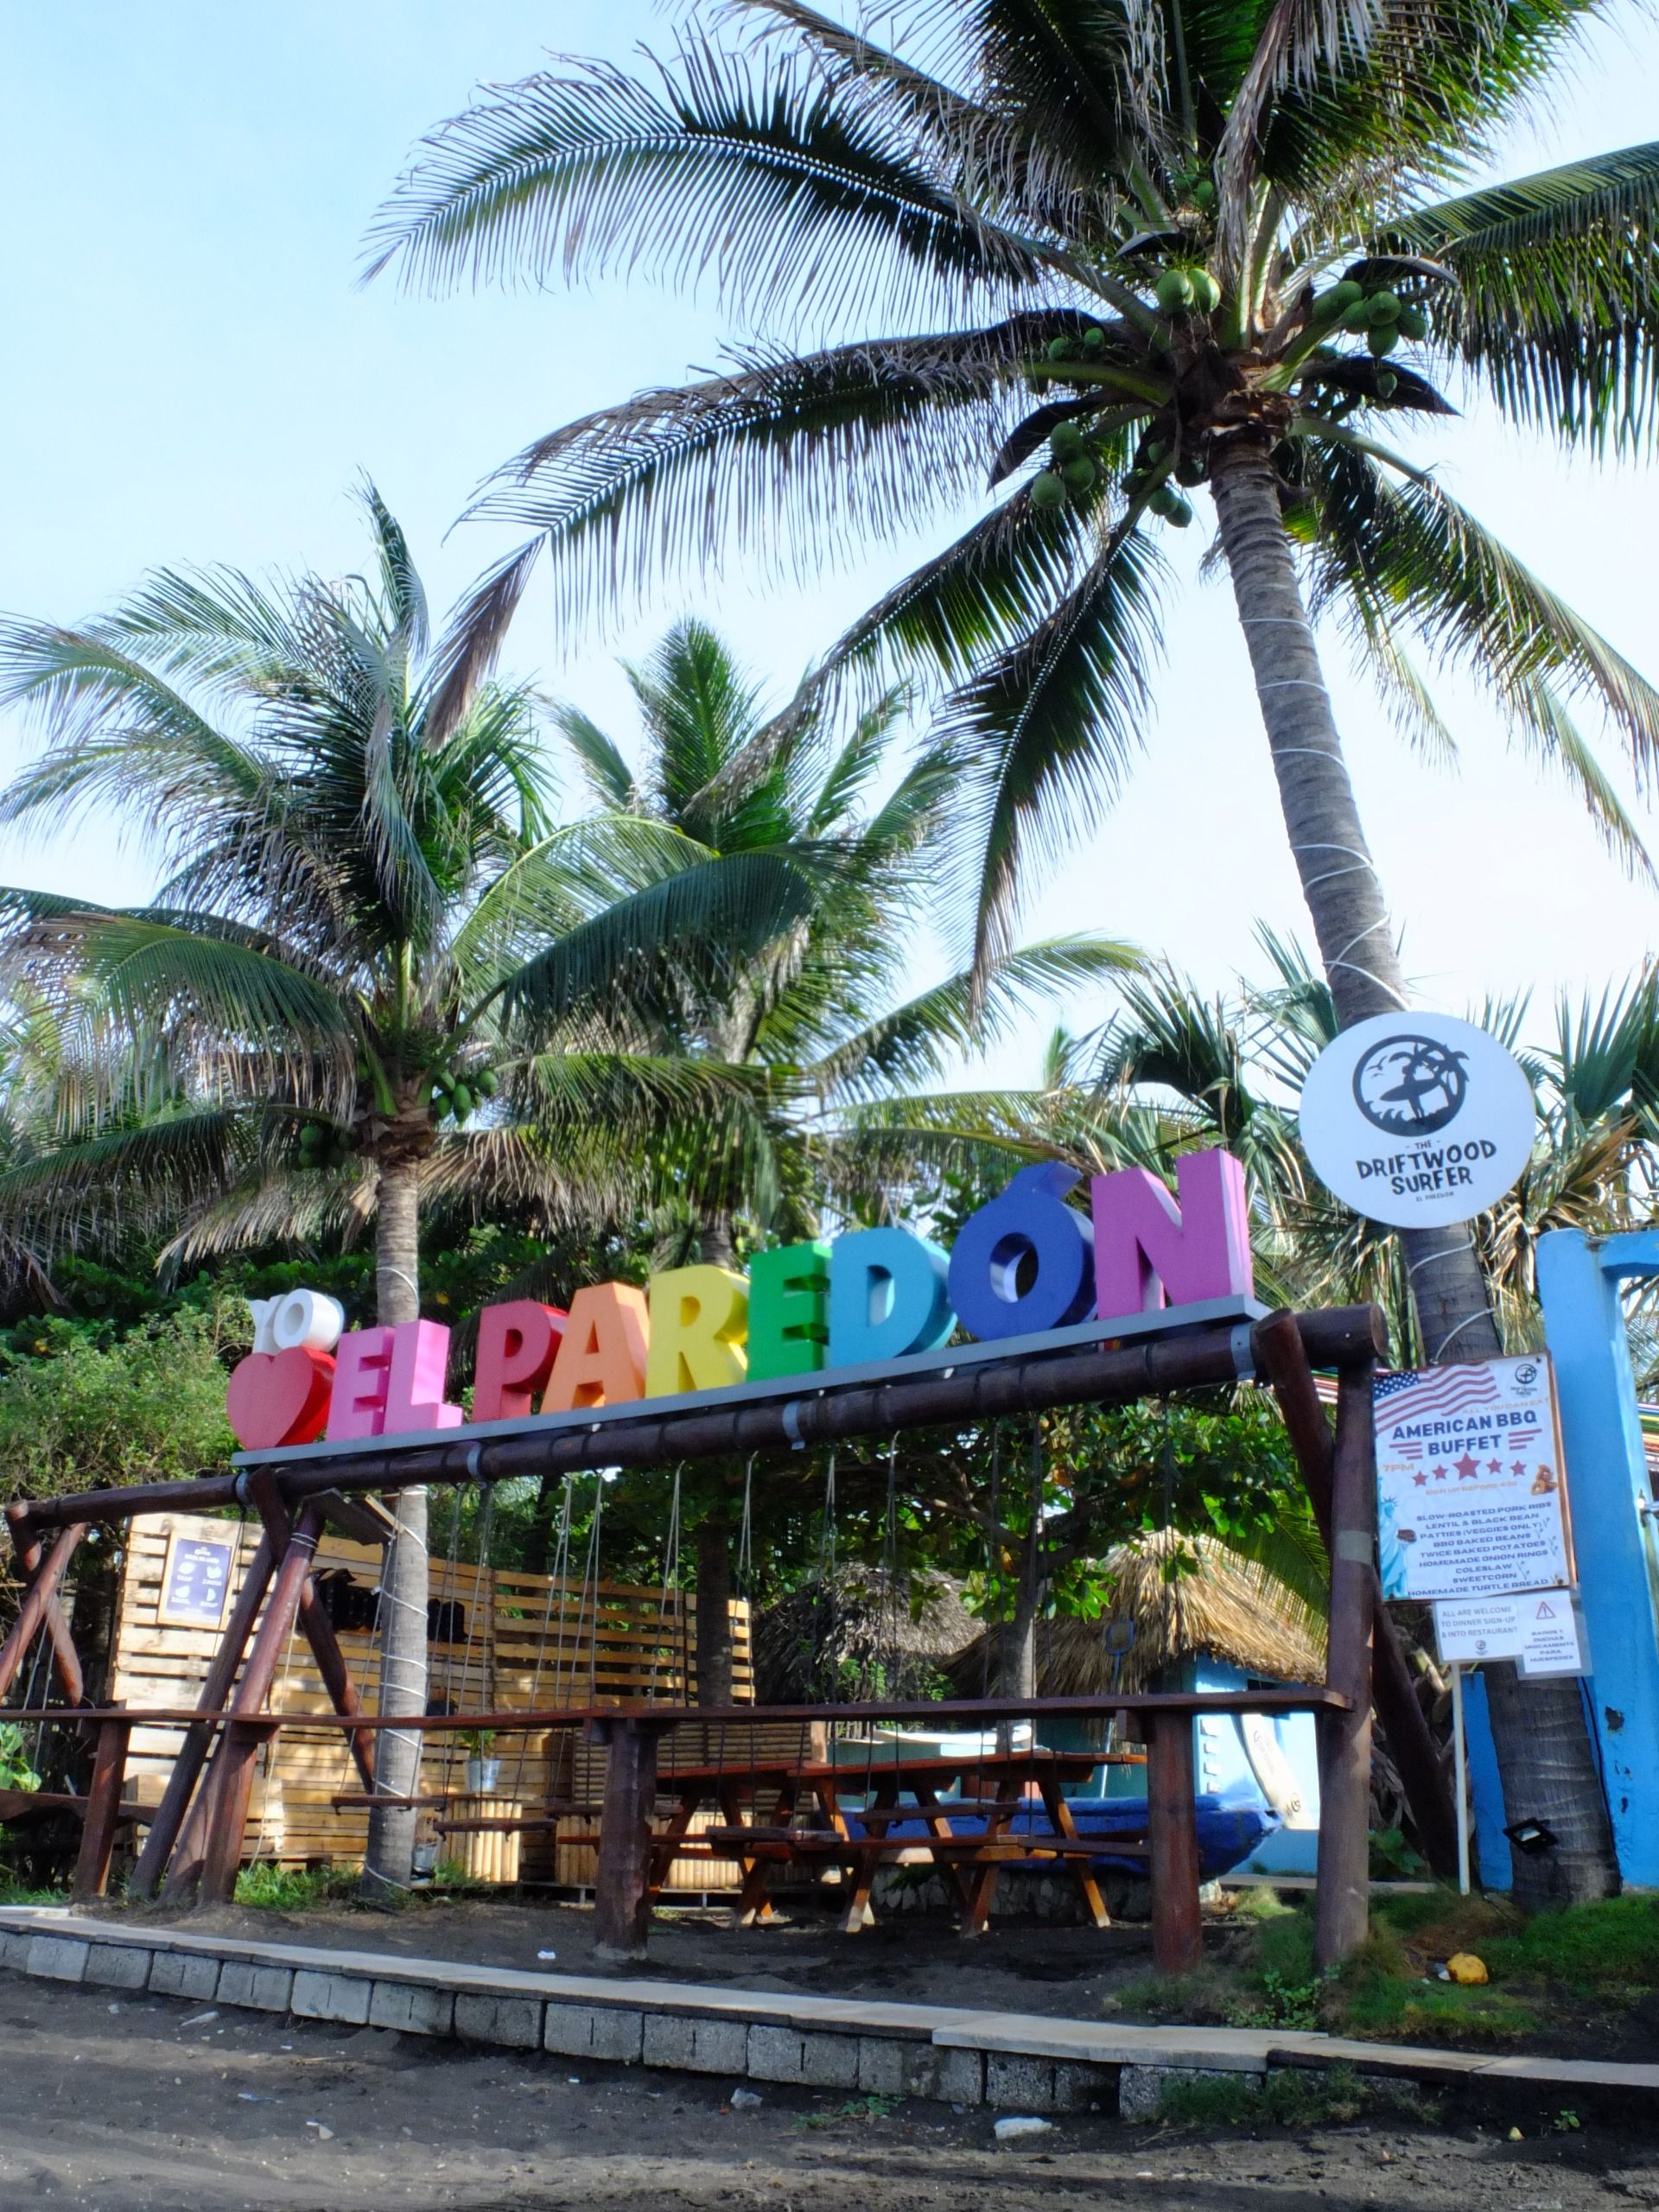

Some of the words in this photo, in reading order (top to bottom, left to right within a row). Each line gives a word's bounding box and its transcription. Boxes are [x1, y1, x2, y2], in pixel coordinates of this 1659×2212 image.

[1414, 1139, 1433, 1149] THE
[1355, 1139, 1497, 1179] DRIFTWOOD
[1390, 1166, 1473, 1196] SURFER
[326, 1319, 462, 1442] EL
[473, 1148, 1255, 1422] PAREDÓN
[248, 1288, 344, 1355] YO
[1392, 1414, 1492, 1440] AMERICAN
[1496, 1409, 1538, 1427] BBQ
[1427, 1434, 1502, 1456] BUFFET
[1416, 1508, 1496, 1522] SLOW-ROASTED
[1497, 1505, 1527, 1514] PORK
[1528, 1501, 1552, 1510] RIBS
[1426, 1521, 1460, 1529] LENTIL
[1471, 1516, 1507, 1525] BLACK
[1509, 1513, 1539, 1522] BEAN
[1420, 1530, 1461, 1540] PATTIES
[1463, 1525, 1509, 1536] (VEGGIES
[1456, 1537, 1494, 1546] BAKED
[1495, 1532, 1531, 1542] BEANS
[1453, 1546, 1491, 1555] BAKED
[1492, 1540, 1547, 1552] POTATOES
[1419, 1556, 1481, 1568] HOMEMADE
[1482, 1554, 1516, 1562] ONION
[1516, 1549, 1548, 1559] RINGS
[1455, 1562, 1513, 1574] COLESLAW
[1452, 1573, 1517, 1585] SWEETCORN
[1407, 1586, 1469, 1597] HOMEMADE
[1471, 1581, 1510, 1592] TURTLE
[1511, 1578, 1548, 1588] BREAD
[1473, 1605, 1512, 1615] WELCOME
[1452, 1618, 1482, 1627] DINNER
[1467, 1626, 1518, 1636] RESTAURANT
